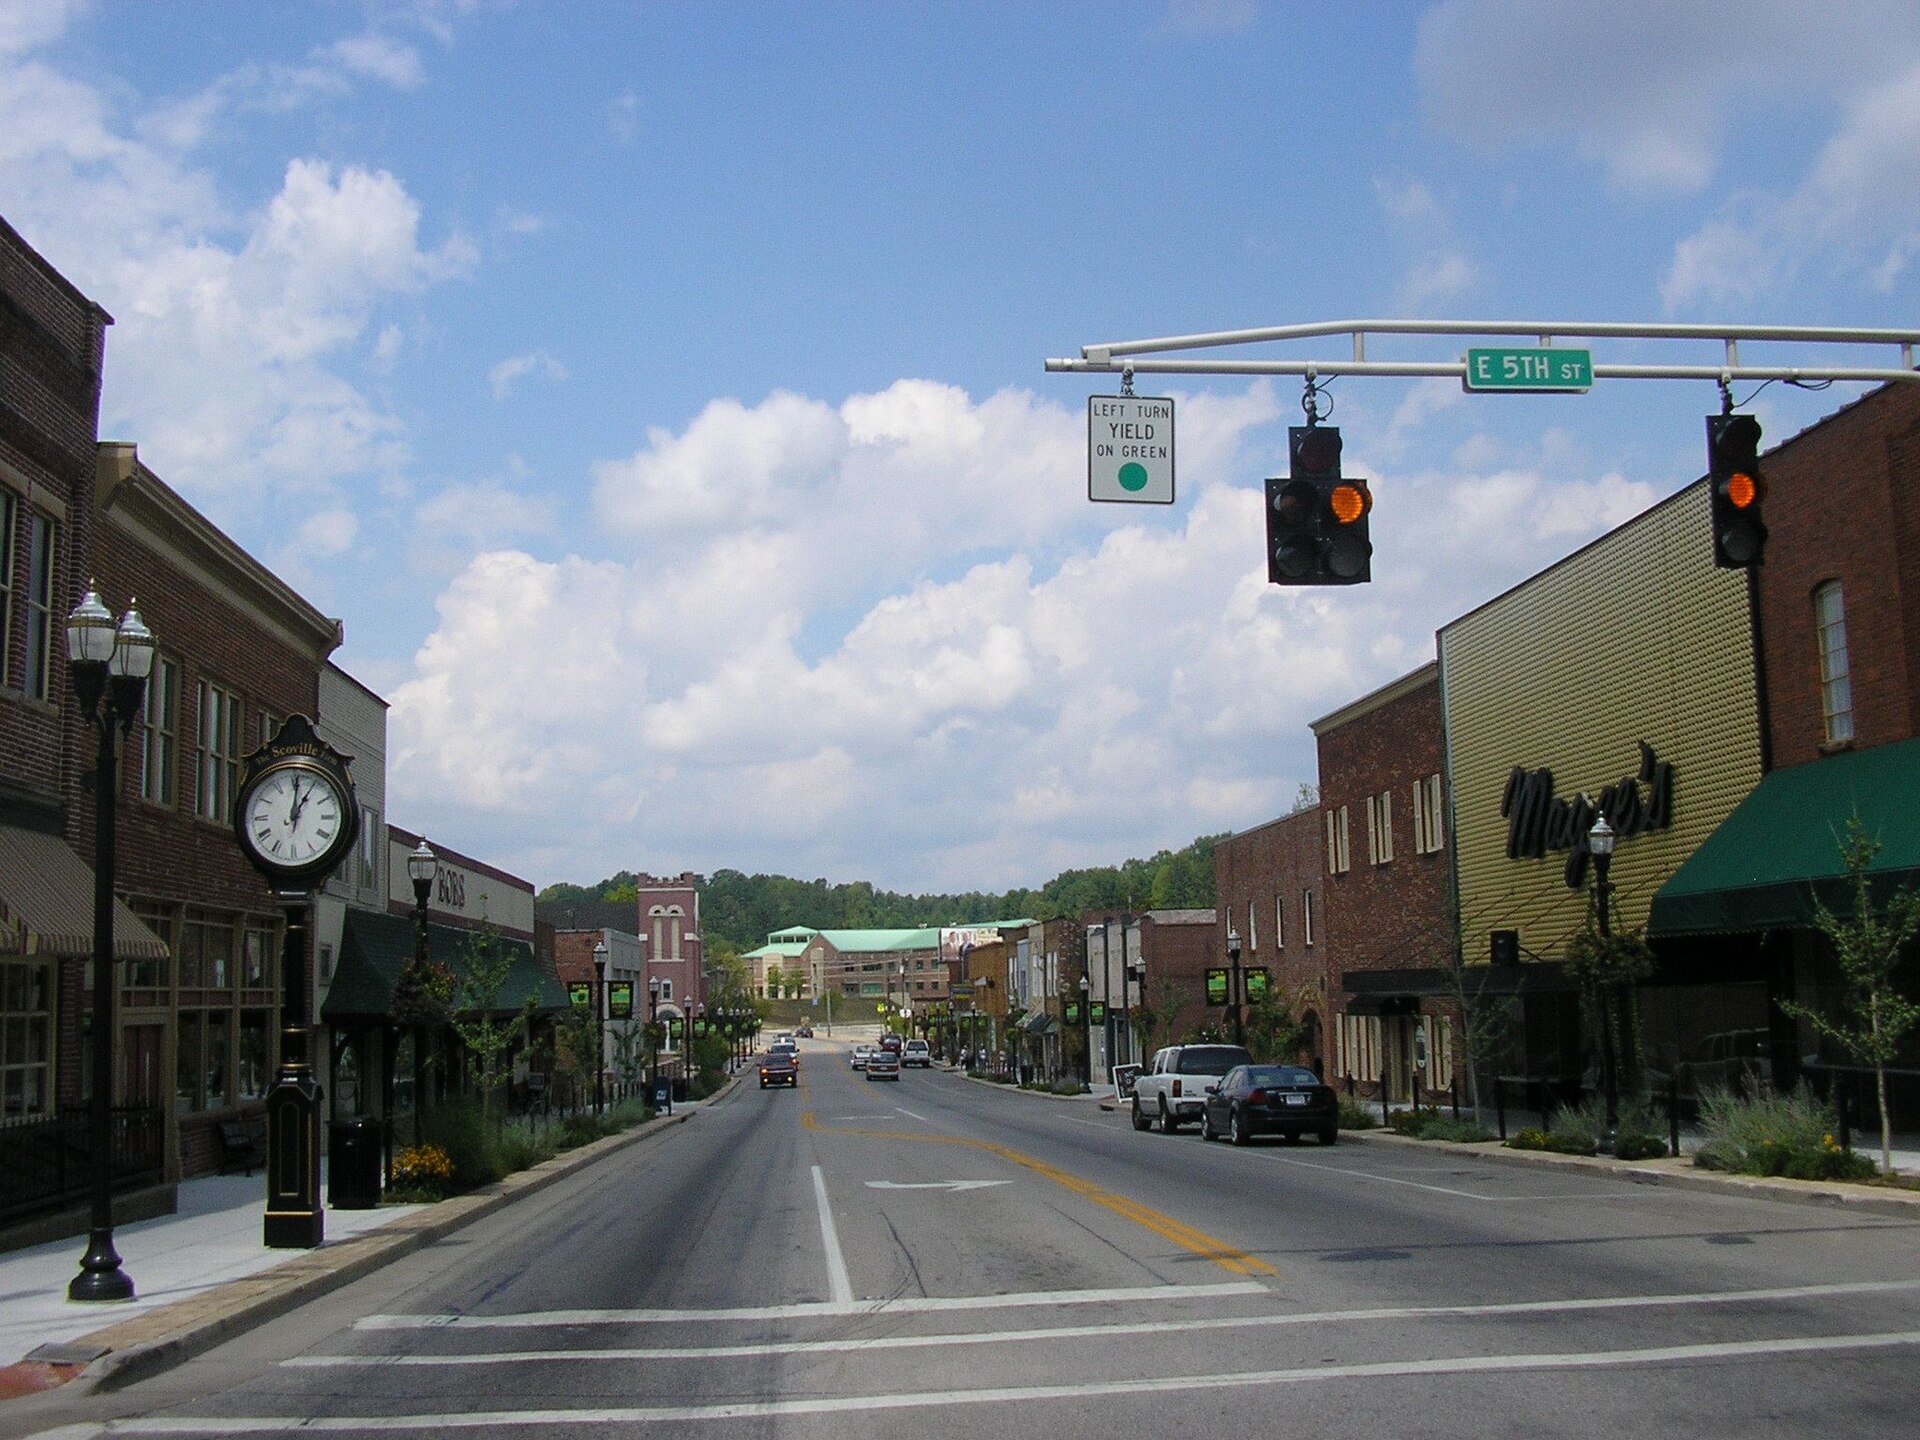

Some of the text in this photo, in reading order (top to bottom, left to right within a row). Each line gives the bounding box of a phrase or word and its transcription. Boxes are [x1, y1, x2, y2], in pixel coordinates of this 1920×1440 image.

[1476, 356, 1582, 379] E 5TH ST
[1094, 404, 1169, 418] LEFT TURN
[1109, 422, 1155, 440] YIELD
[1096, 444, 1167, 458] ON GREEN
[271, 742, 319, 758] Scoville
